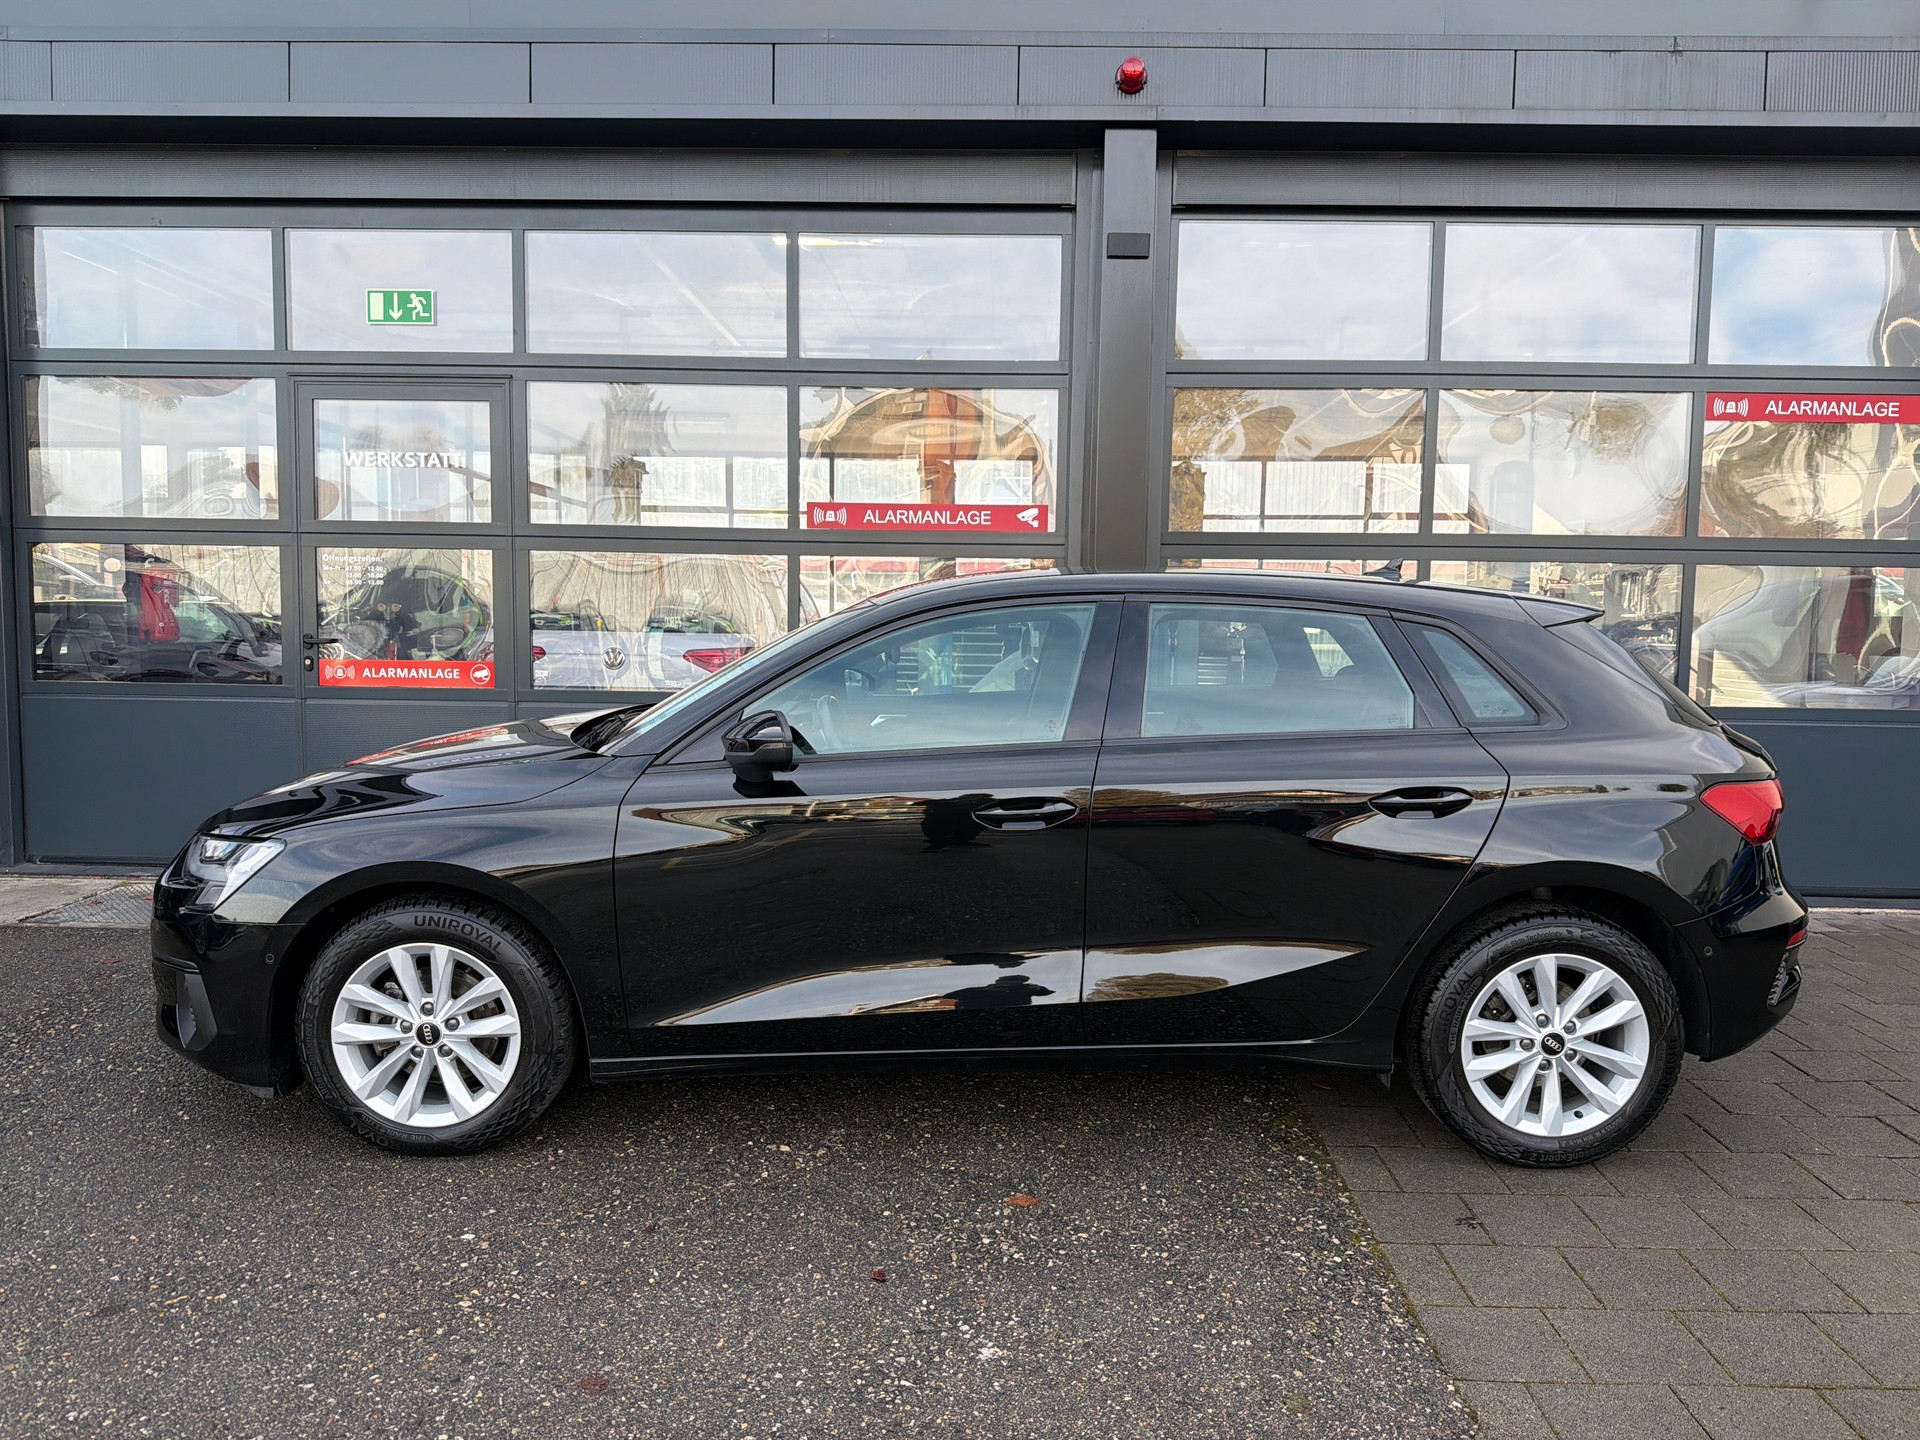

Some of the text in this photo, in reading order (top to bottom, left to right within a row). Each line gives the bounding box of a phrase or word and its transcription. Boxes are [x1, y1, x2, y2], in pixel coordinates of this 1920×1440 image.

[1765, 400, 1901, 417] ALARMANLAGE
[343, 451, 464, 468] WERKSTATT
[863, 509, 992, 525] ALARMANLAGE
[362, 667, 461, 679] ALARMANLAGE
[414, 915, 504, 953] UNIROYAL
